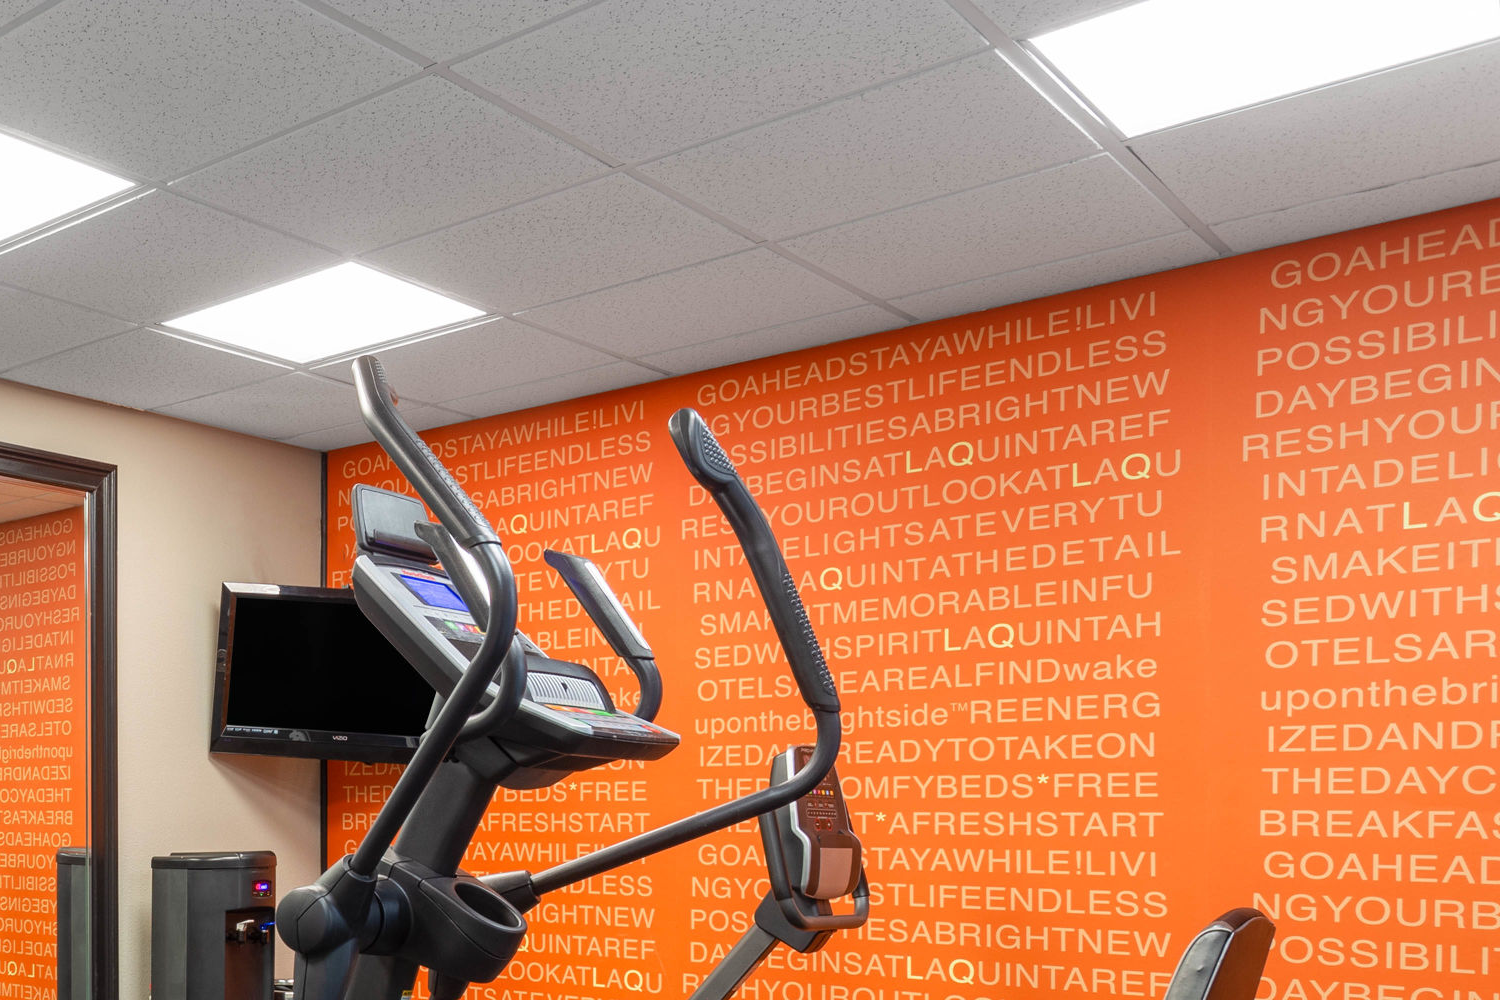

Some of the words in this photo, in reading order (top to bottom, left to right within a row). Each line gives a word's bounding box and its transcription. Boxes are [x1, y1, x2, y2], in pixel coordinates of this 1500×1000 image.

[697, 292, 1157, 407] GOAHEADSTAYAWHILE!LIVI
[706, 330, 1167, 437] GYOURBESTLIFEENDLESS
[730, 369, 1171, 467] SSIBILITIESABRIGHTNEW
[689, 410, 1172, 507] DBEGINSATLAQUINTAREF
[1263, 447, 1500, 501] INTADELI
[681, 449, 1182, 540] RESYOUROUTLOOKATLAQU
[694, 491, 1163, 571] INTELIGHTSATEVERYTU
[693, 530, 1182, 604] RNAAQUINTATHEDETAIL
[1271, 537, 1500, 584] SMAKEIT
[1261, 584, 1500, 627] SEDWITH
[694, 612, 1161, 669] SEDWHSPIRITLAQUINTAH
[697, 655, 1156, 702] OTELSEAREALFINDwake
[694, 692, 1161, 739] uponthebghtside™REENERG
[699, 733, 1156, 768] IZEDAREADYTOTAKEON
[1262, 765, 1497, 795] THEDAYC
[1259, 809, 1500, 840] BREAKFA
[691, 877, 1168, 918] NGYOSTLIFEENDLESS
[690, 942, 1171, 998] DAEGINSATLAQUINTAREF
[1269, 935, 1500, 975] OSSIBILI
